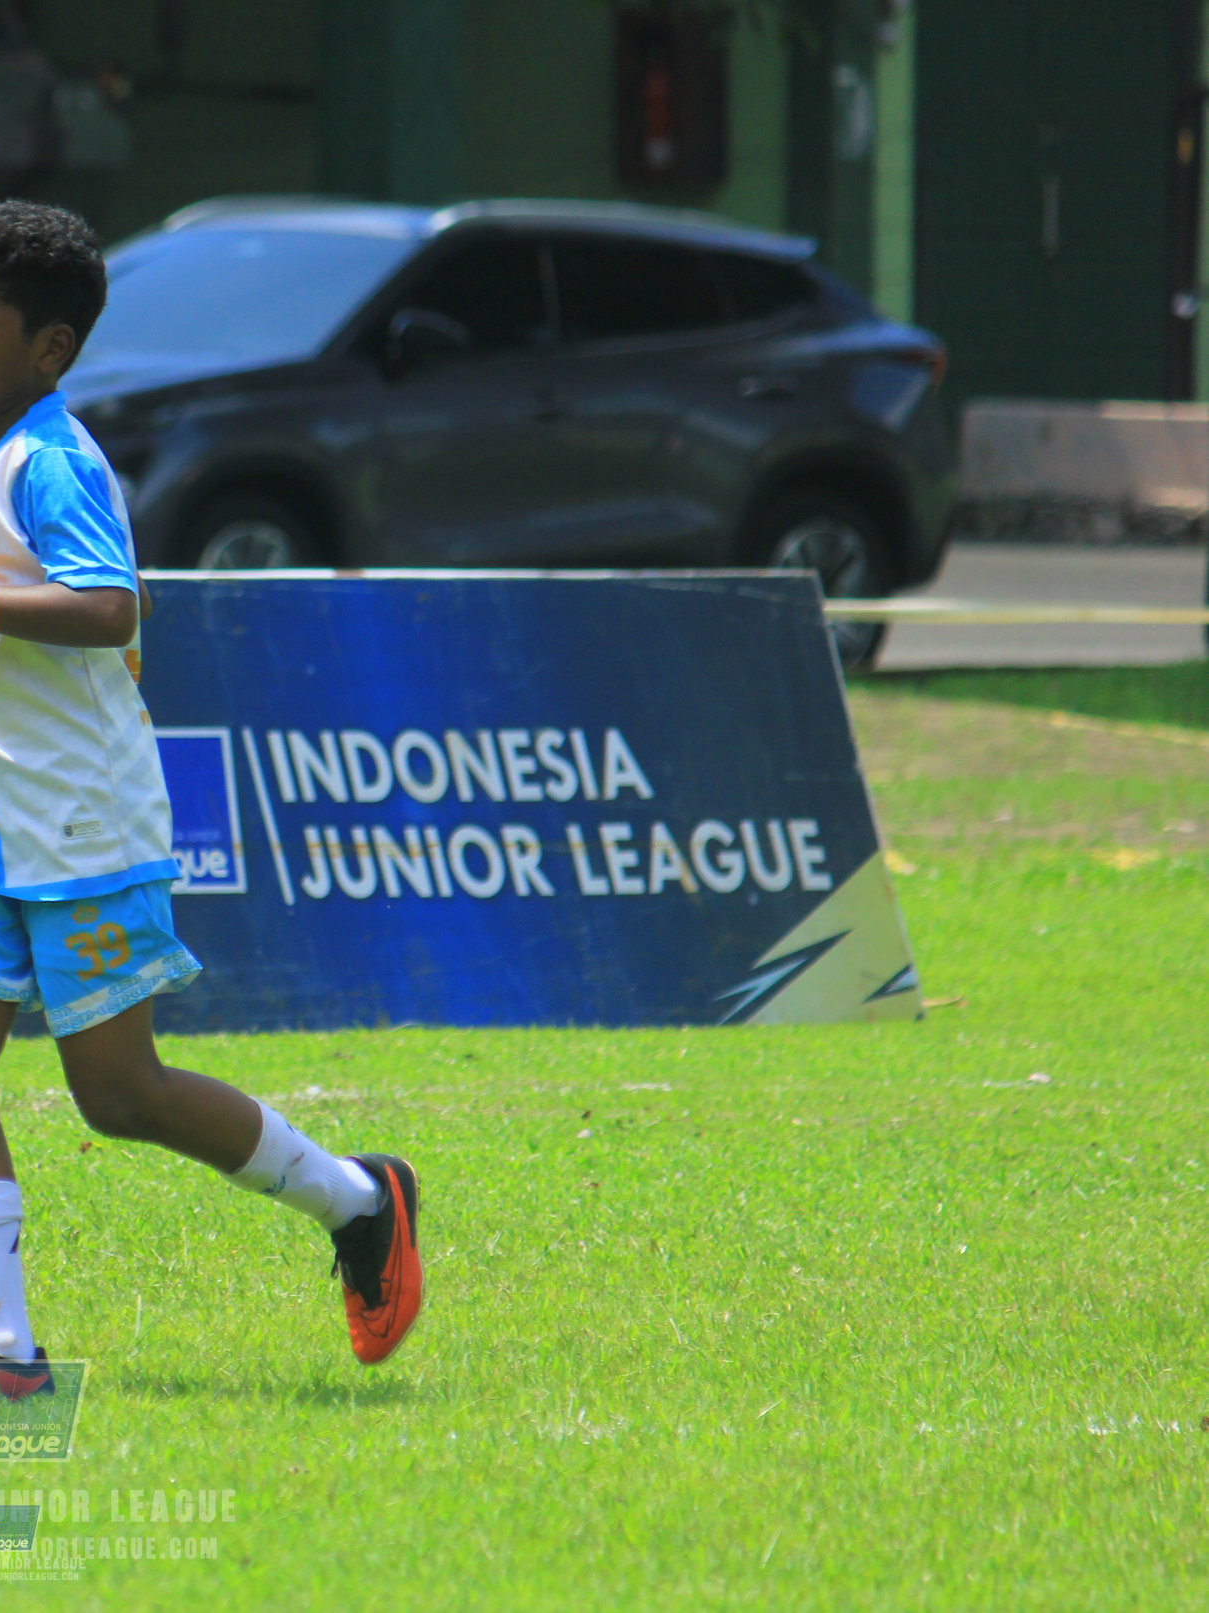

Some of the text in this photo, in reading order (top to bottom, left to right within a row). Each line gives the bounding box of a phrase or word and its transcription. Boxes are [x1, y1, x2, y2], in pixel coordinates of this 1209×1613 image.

[267, 727, 653, 802] INDONESIA
[172, 847, 229, 888] gue
[301, 818, 833, 899] JUNIOR LEAGUE
[64, 921, 133, 982] 39
